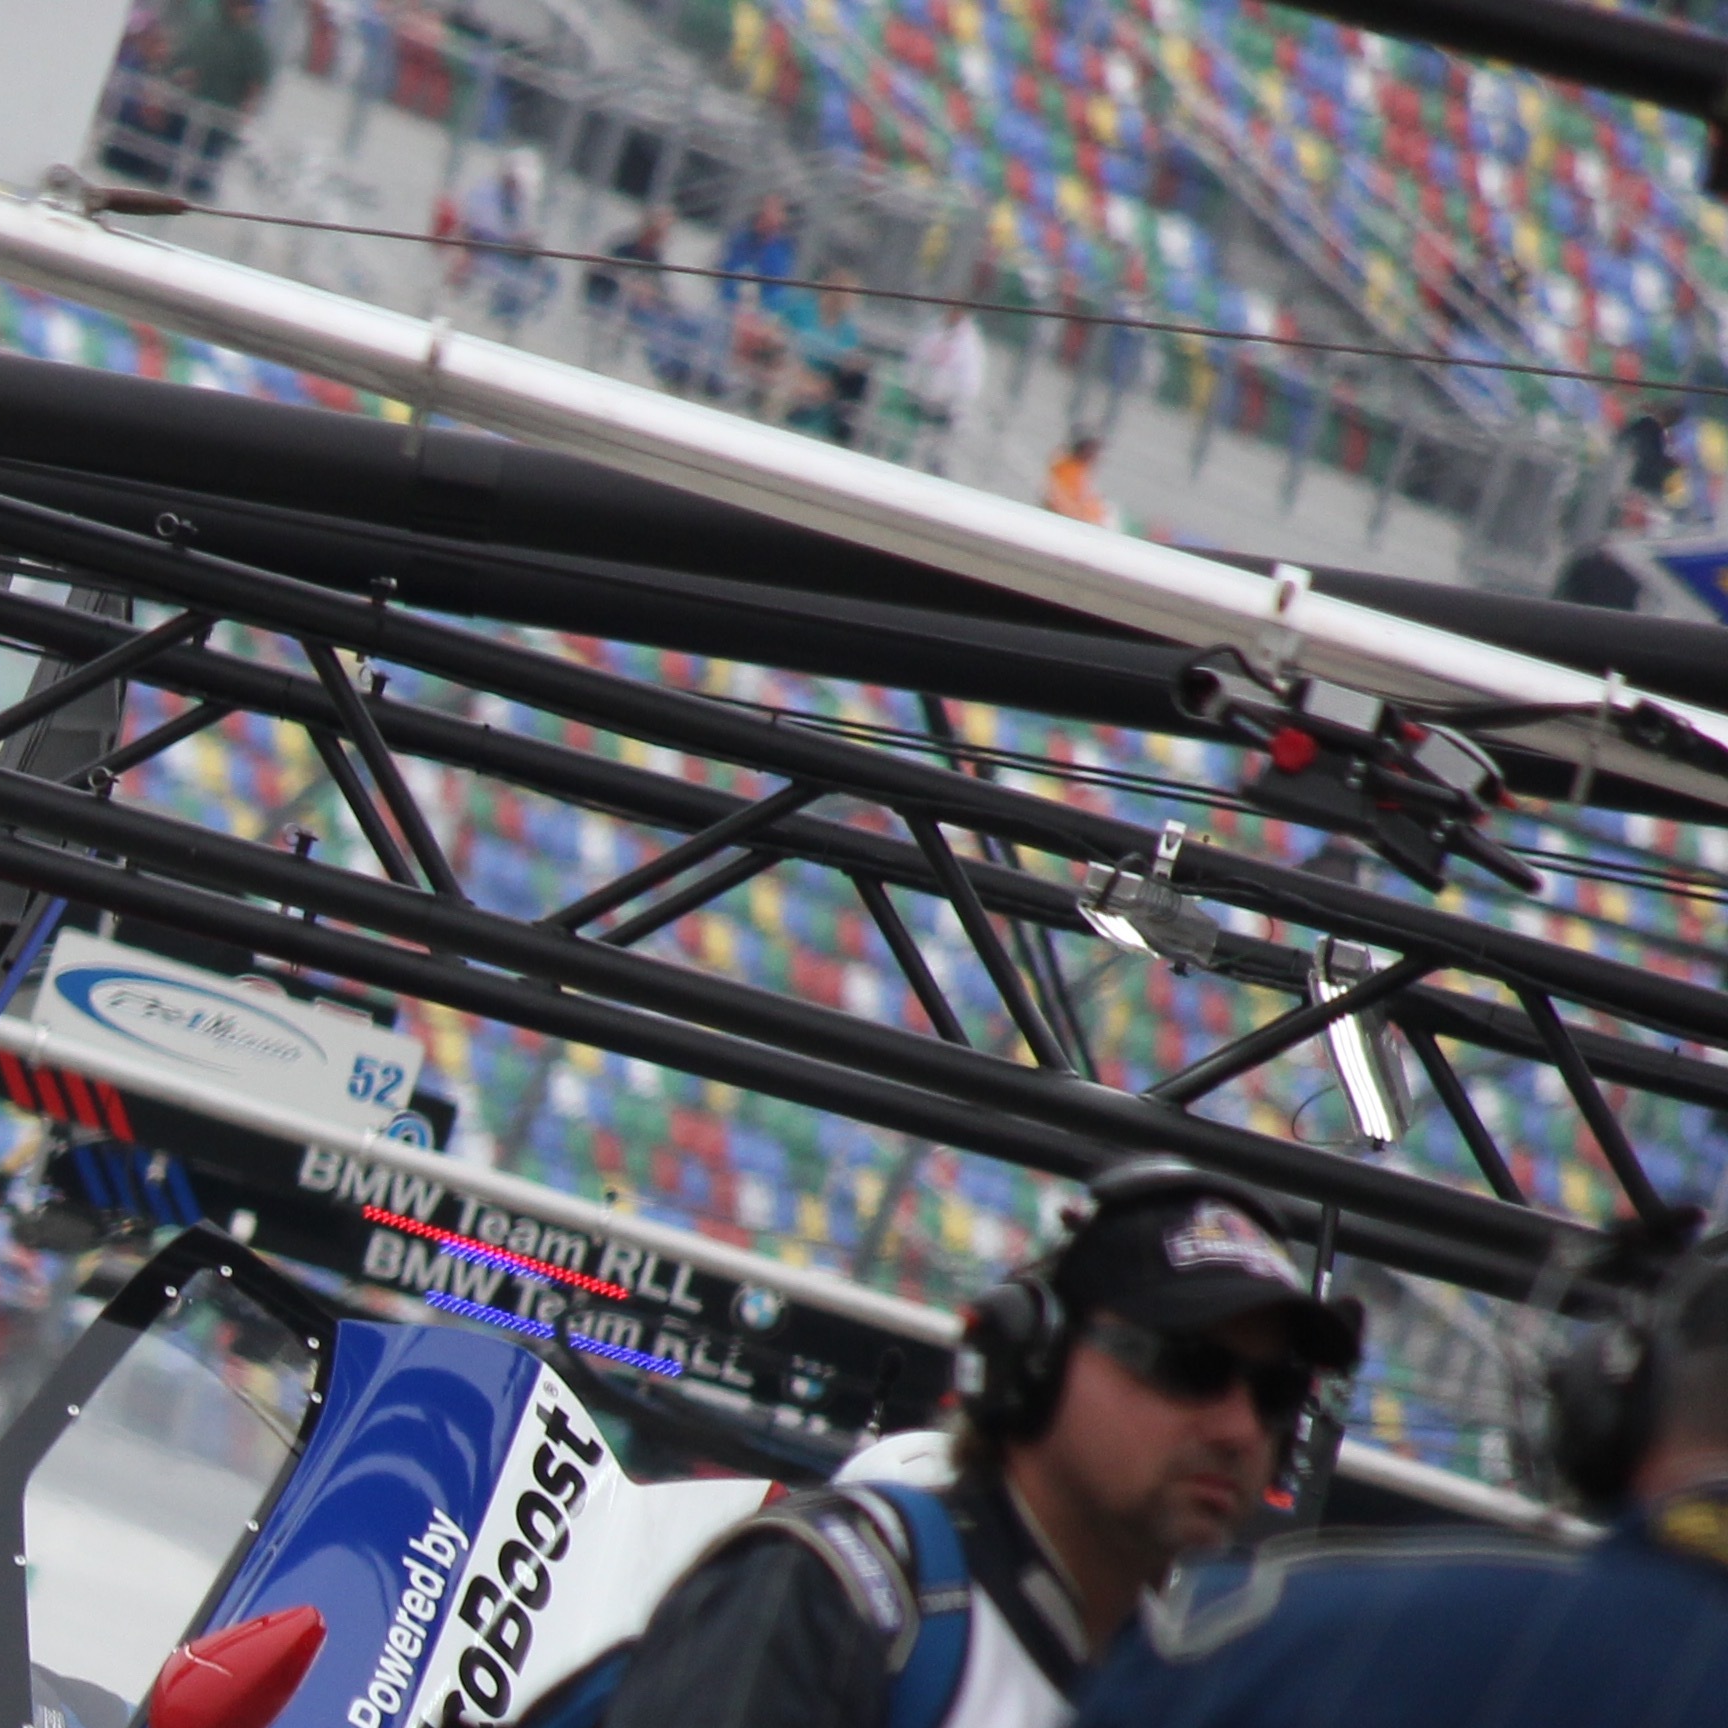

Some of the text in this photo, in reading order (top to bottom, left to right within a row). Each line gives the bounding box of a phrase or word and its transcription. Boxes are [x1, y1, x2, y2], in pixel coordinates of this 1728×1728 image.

[347, 1054, 406, 1111] 52
[298, 1143, 702, 1314] BMW Team RLL
[362, 1229, 507, 1308] BMW
[510, 1271, 643, 1351] Team
[408, 1507, 470, 1568] by
